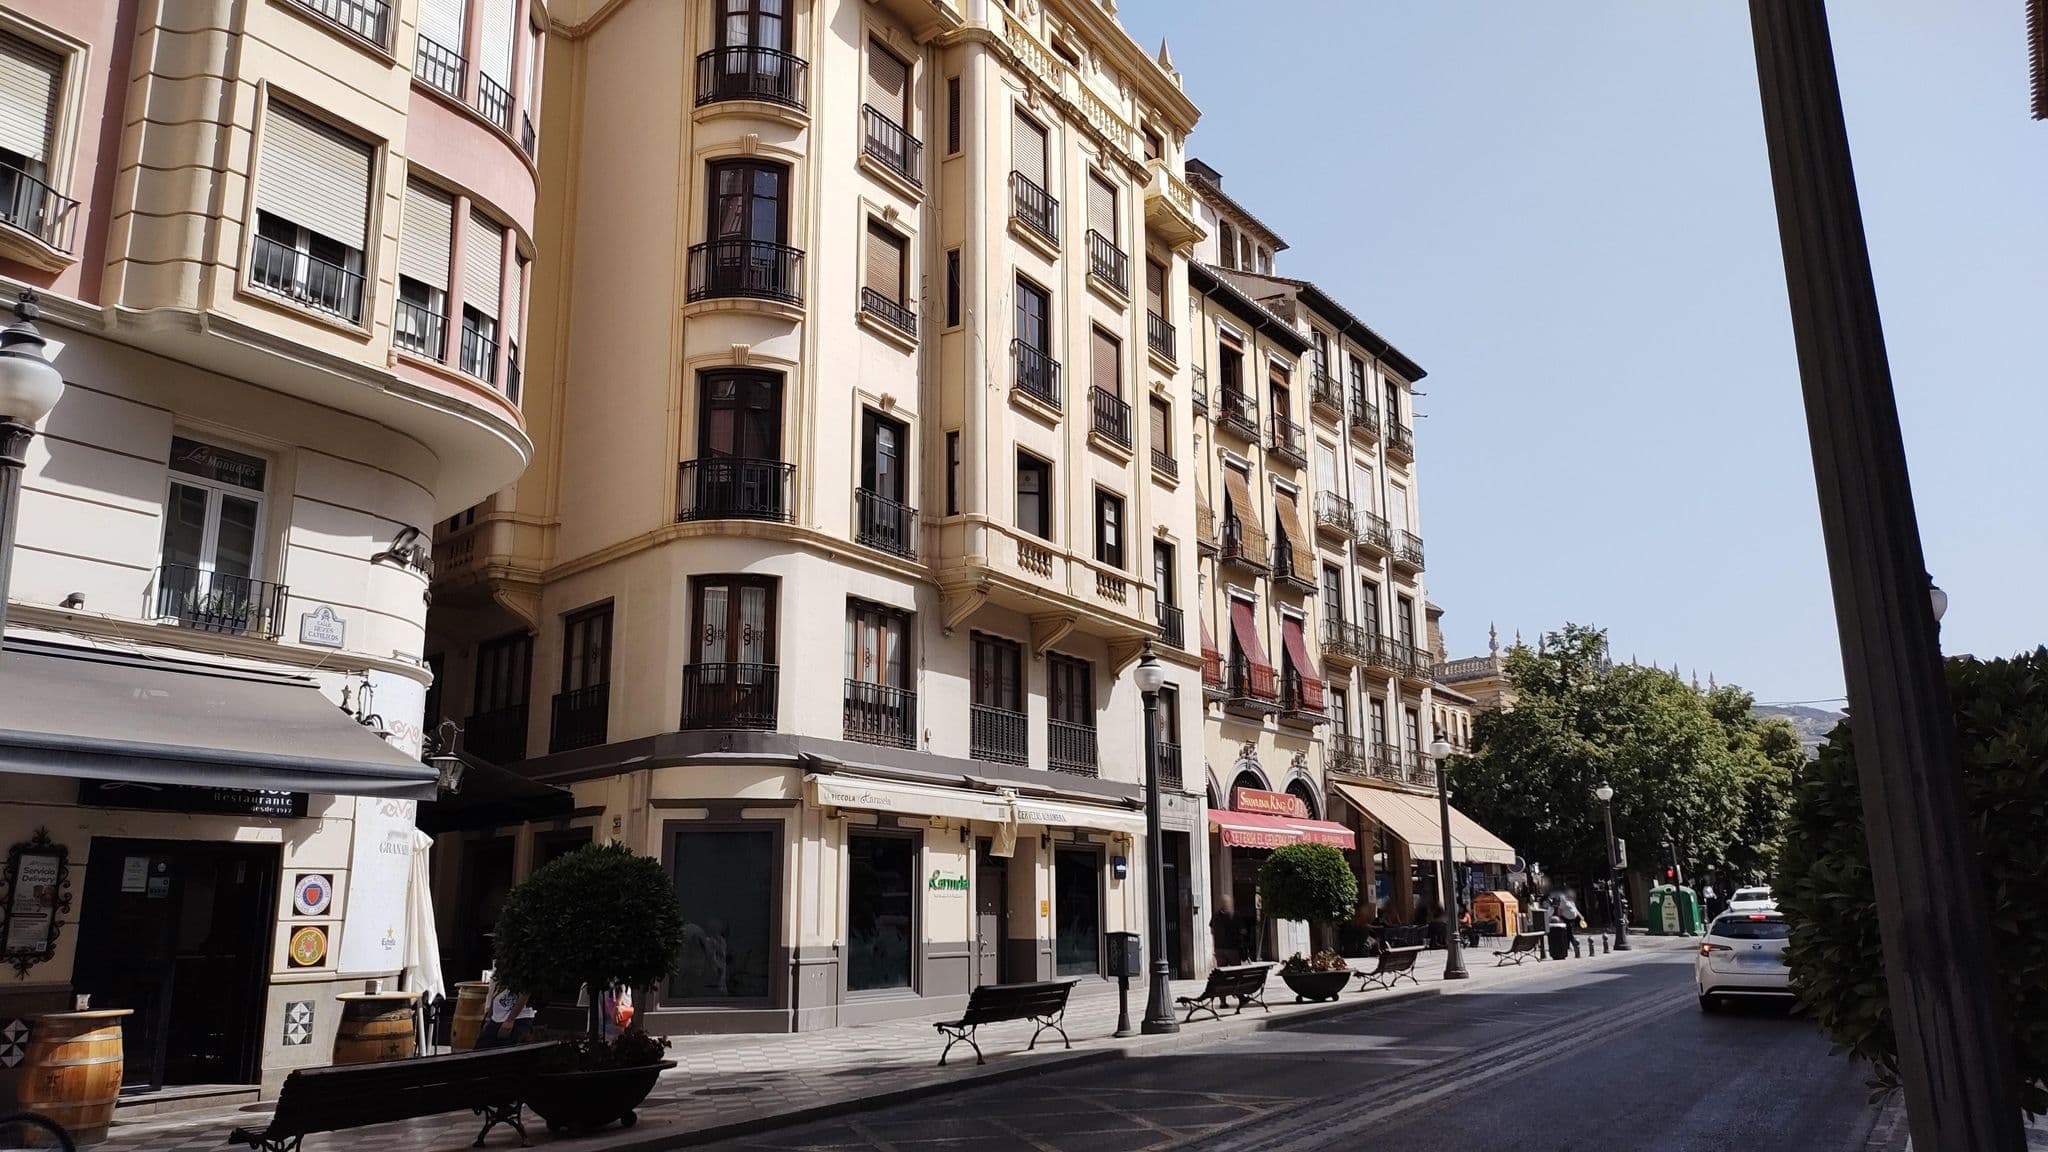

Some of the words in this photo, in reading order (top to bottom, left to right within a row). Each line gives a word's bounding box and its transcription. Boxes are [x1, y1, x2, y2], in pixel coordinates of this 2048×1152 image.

[214, 791, 292, 807] Restaurante
[832, 793, 855, 802] PICCOLA
[23, 865, 56, 876] Servicio
[22, 874, 55, 885] Delivery
